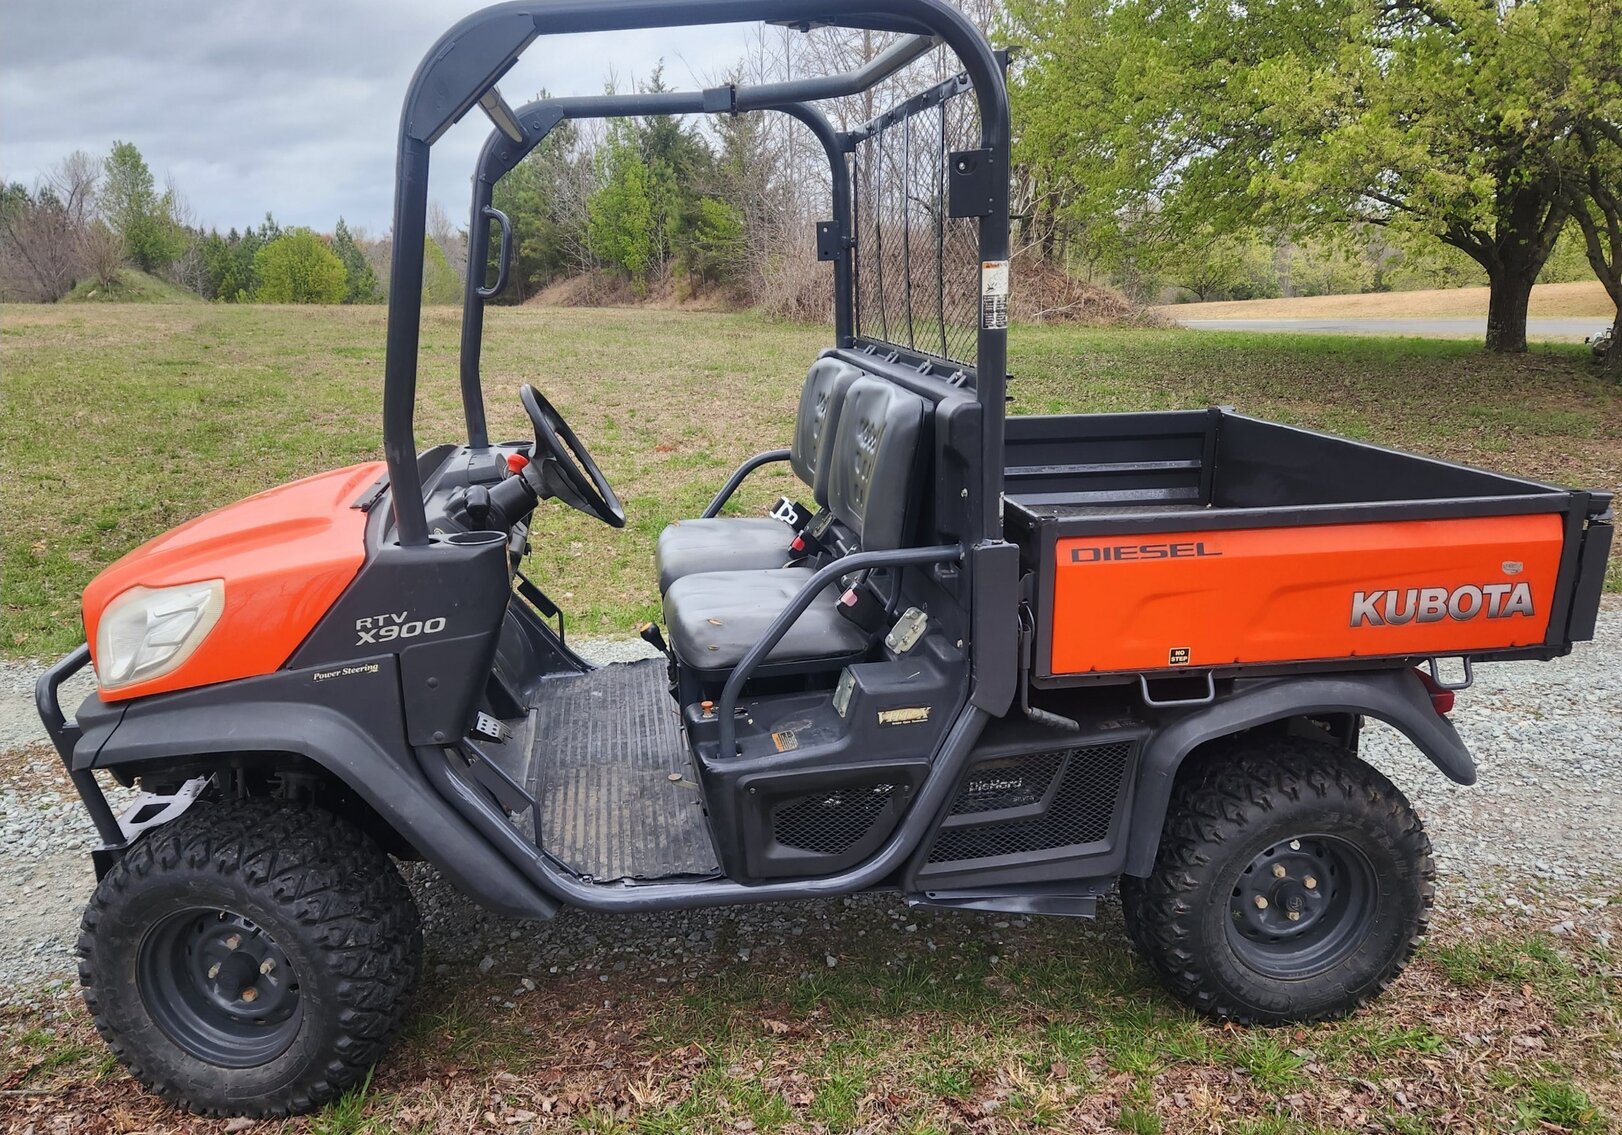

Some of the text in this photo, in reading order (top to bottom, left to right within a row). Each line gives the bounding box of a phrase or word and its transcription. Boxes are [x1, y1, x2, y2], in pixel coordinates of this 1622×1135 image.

[1071, 542, 1223, 563] DIESEL
[1350, 581, 1536, 628] KUBOTA
[355, 611, 408, 631] RTV
[355, 617, 447, 646] X900
[313, 663, 379, 681] Power Steering
